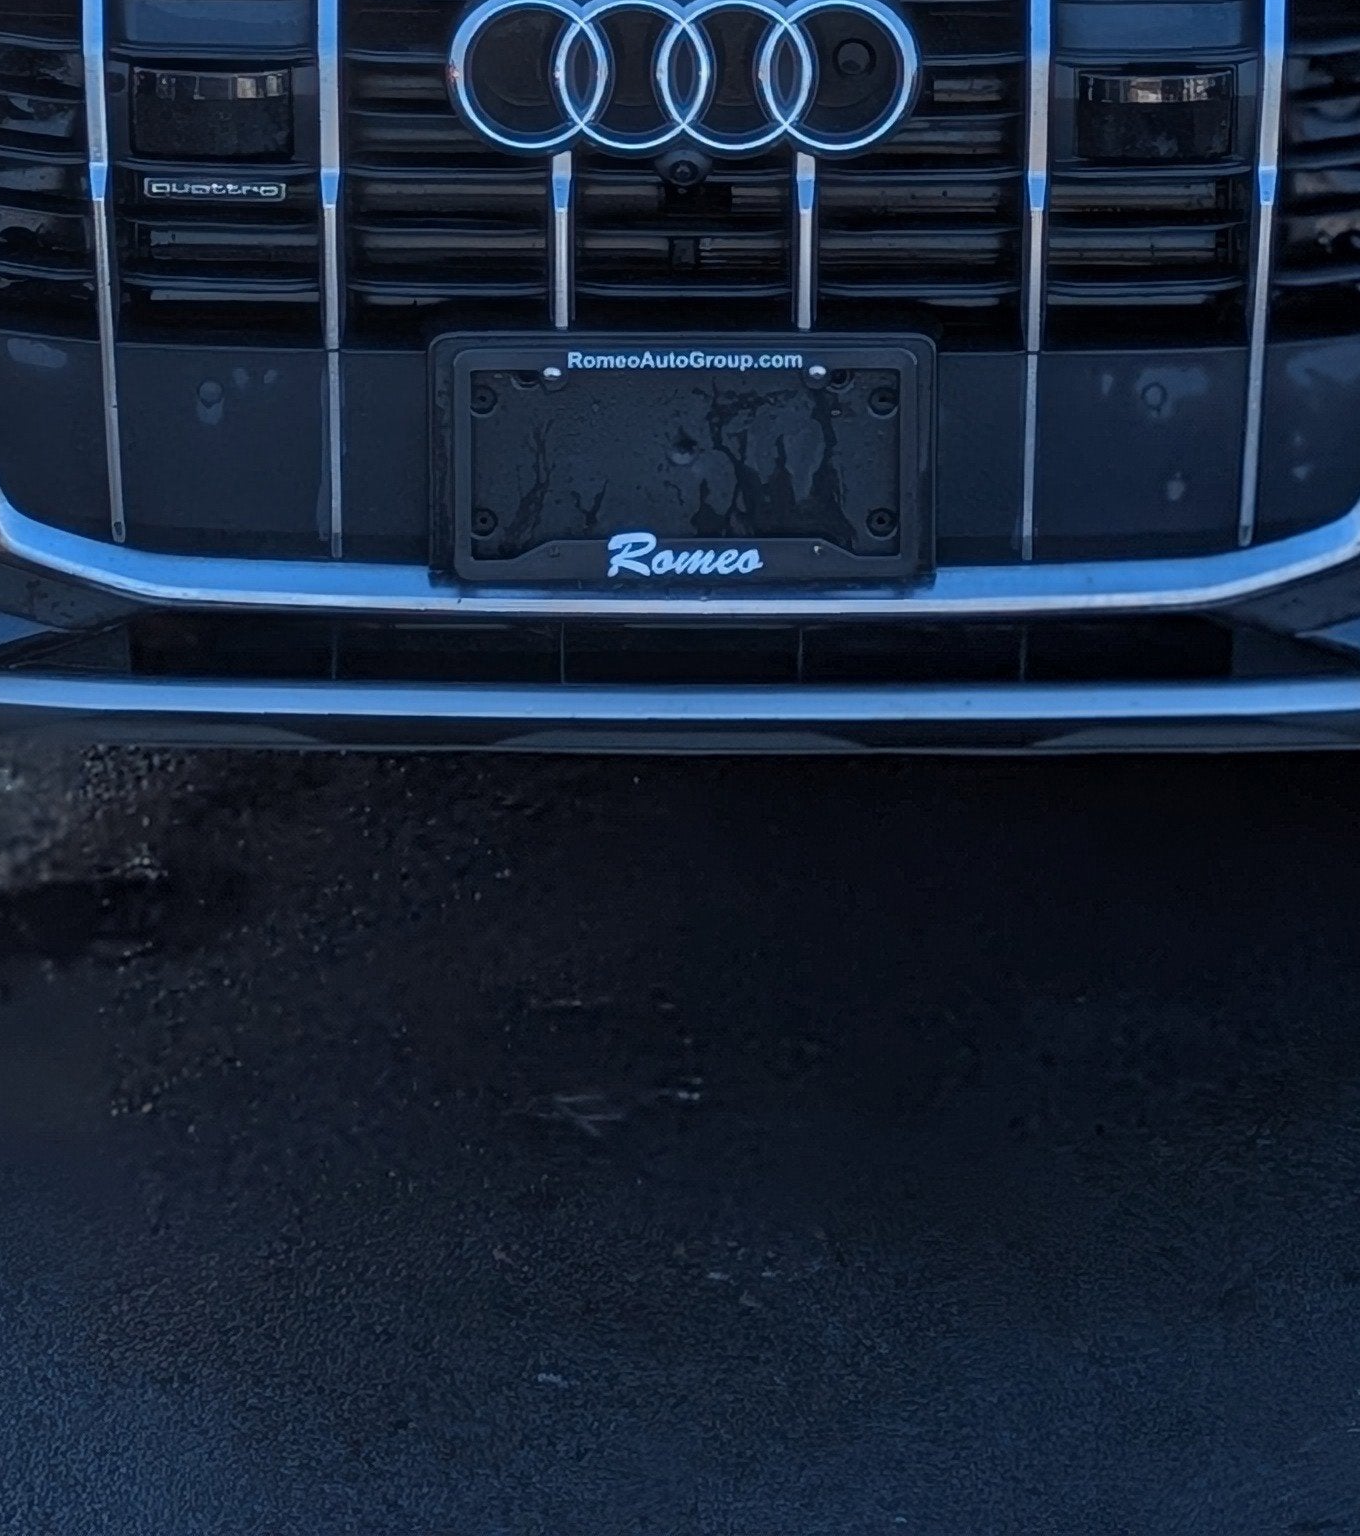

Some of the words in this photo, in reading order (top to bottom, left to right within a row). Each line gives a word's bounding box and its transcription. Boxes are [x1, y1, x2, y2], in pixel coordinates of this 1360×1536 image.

[151, 181, 280, 198] quattro
[566, 350, 804, 372] RomeoAutoGroup.com
[606, 531, 765, 578] Romeo
